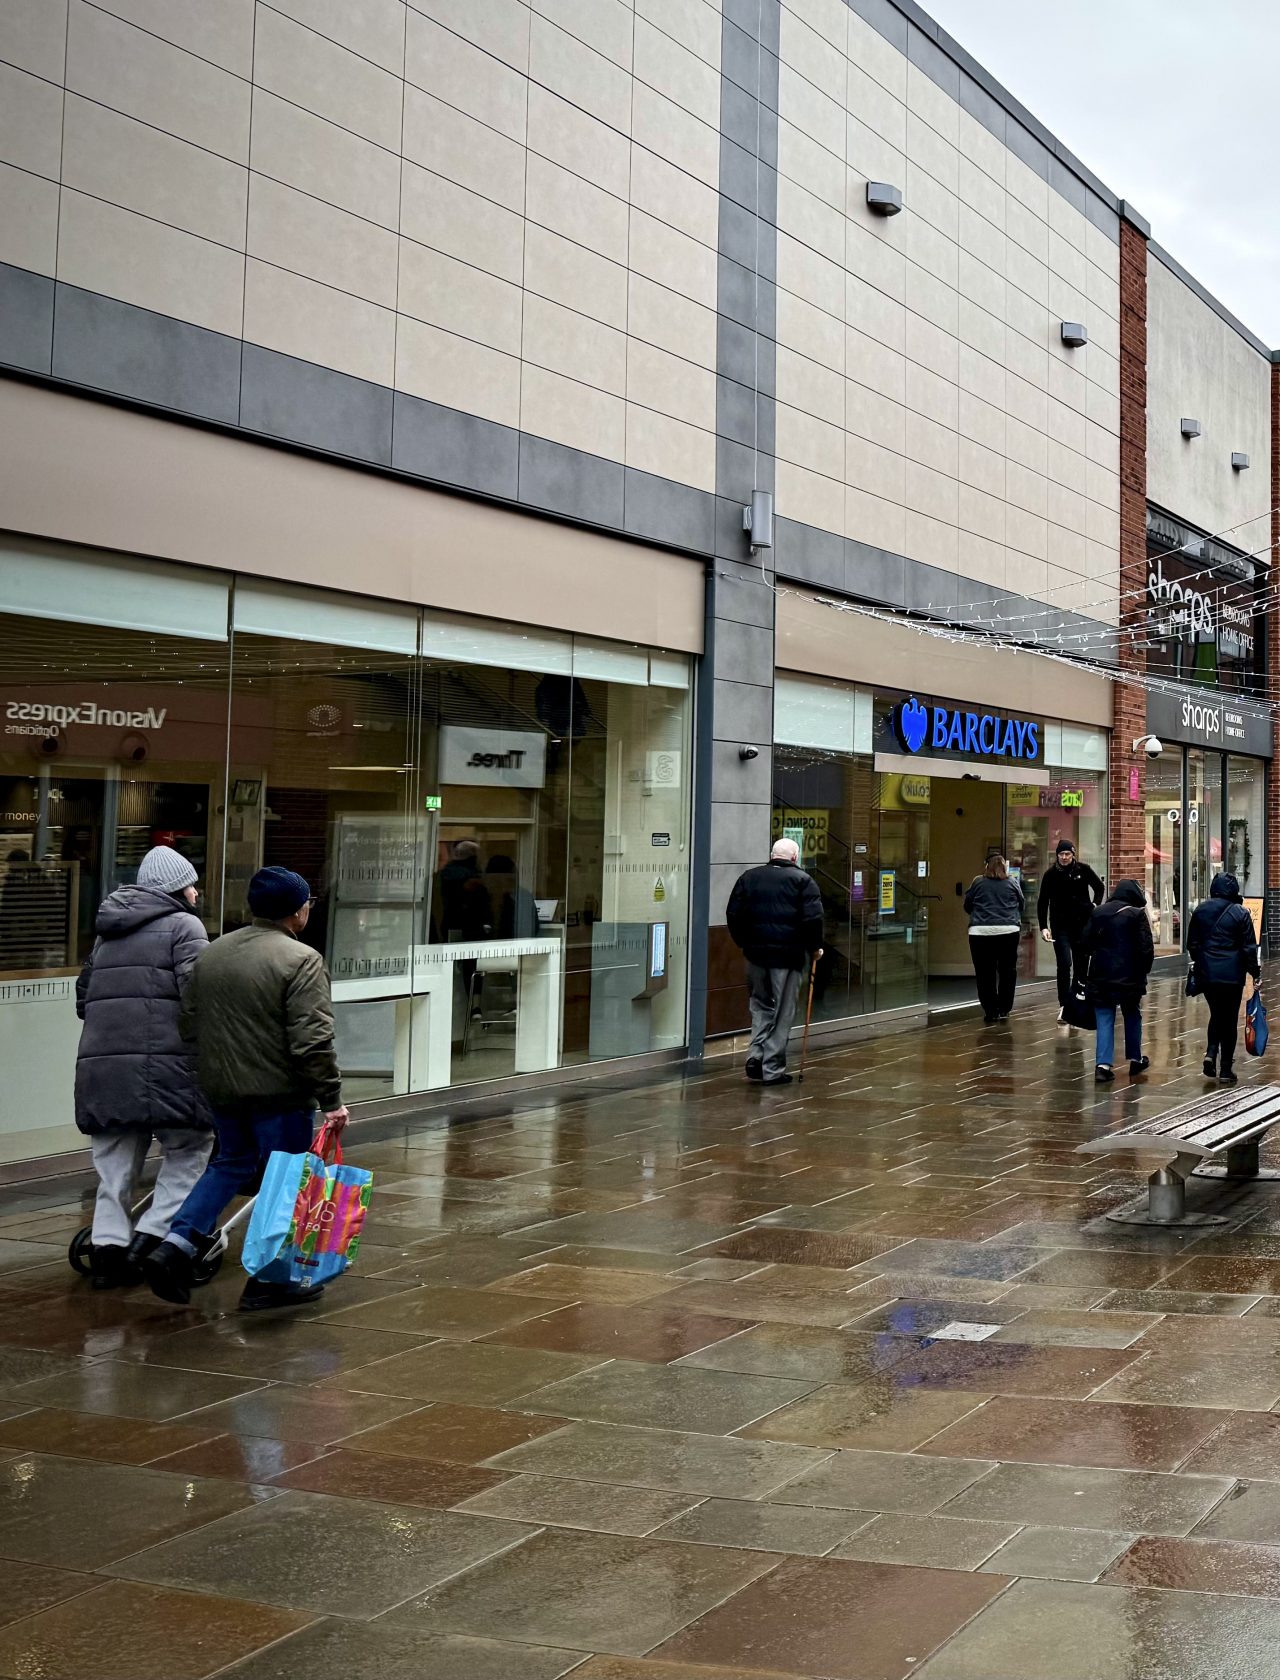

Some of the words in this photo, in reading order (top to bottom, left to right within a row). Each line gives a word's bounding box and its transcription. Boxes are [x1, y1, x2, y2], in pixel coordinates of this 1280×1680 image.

[1222, 625, 1238, 643] HOME
[1238, 631, 1254, 651] OFFICE
[931, 706, 1039, 760] BARCLAYS
[1182, 694, 1220, 740] sharps
[5, 812, 41, 823] money
